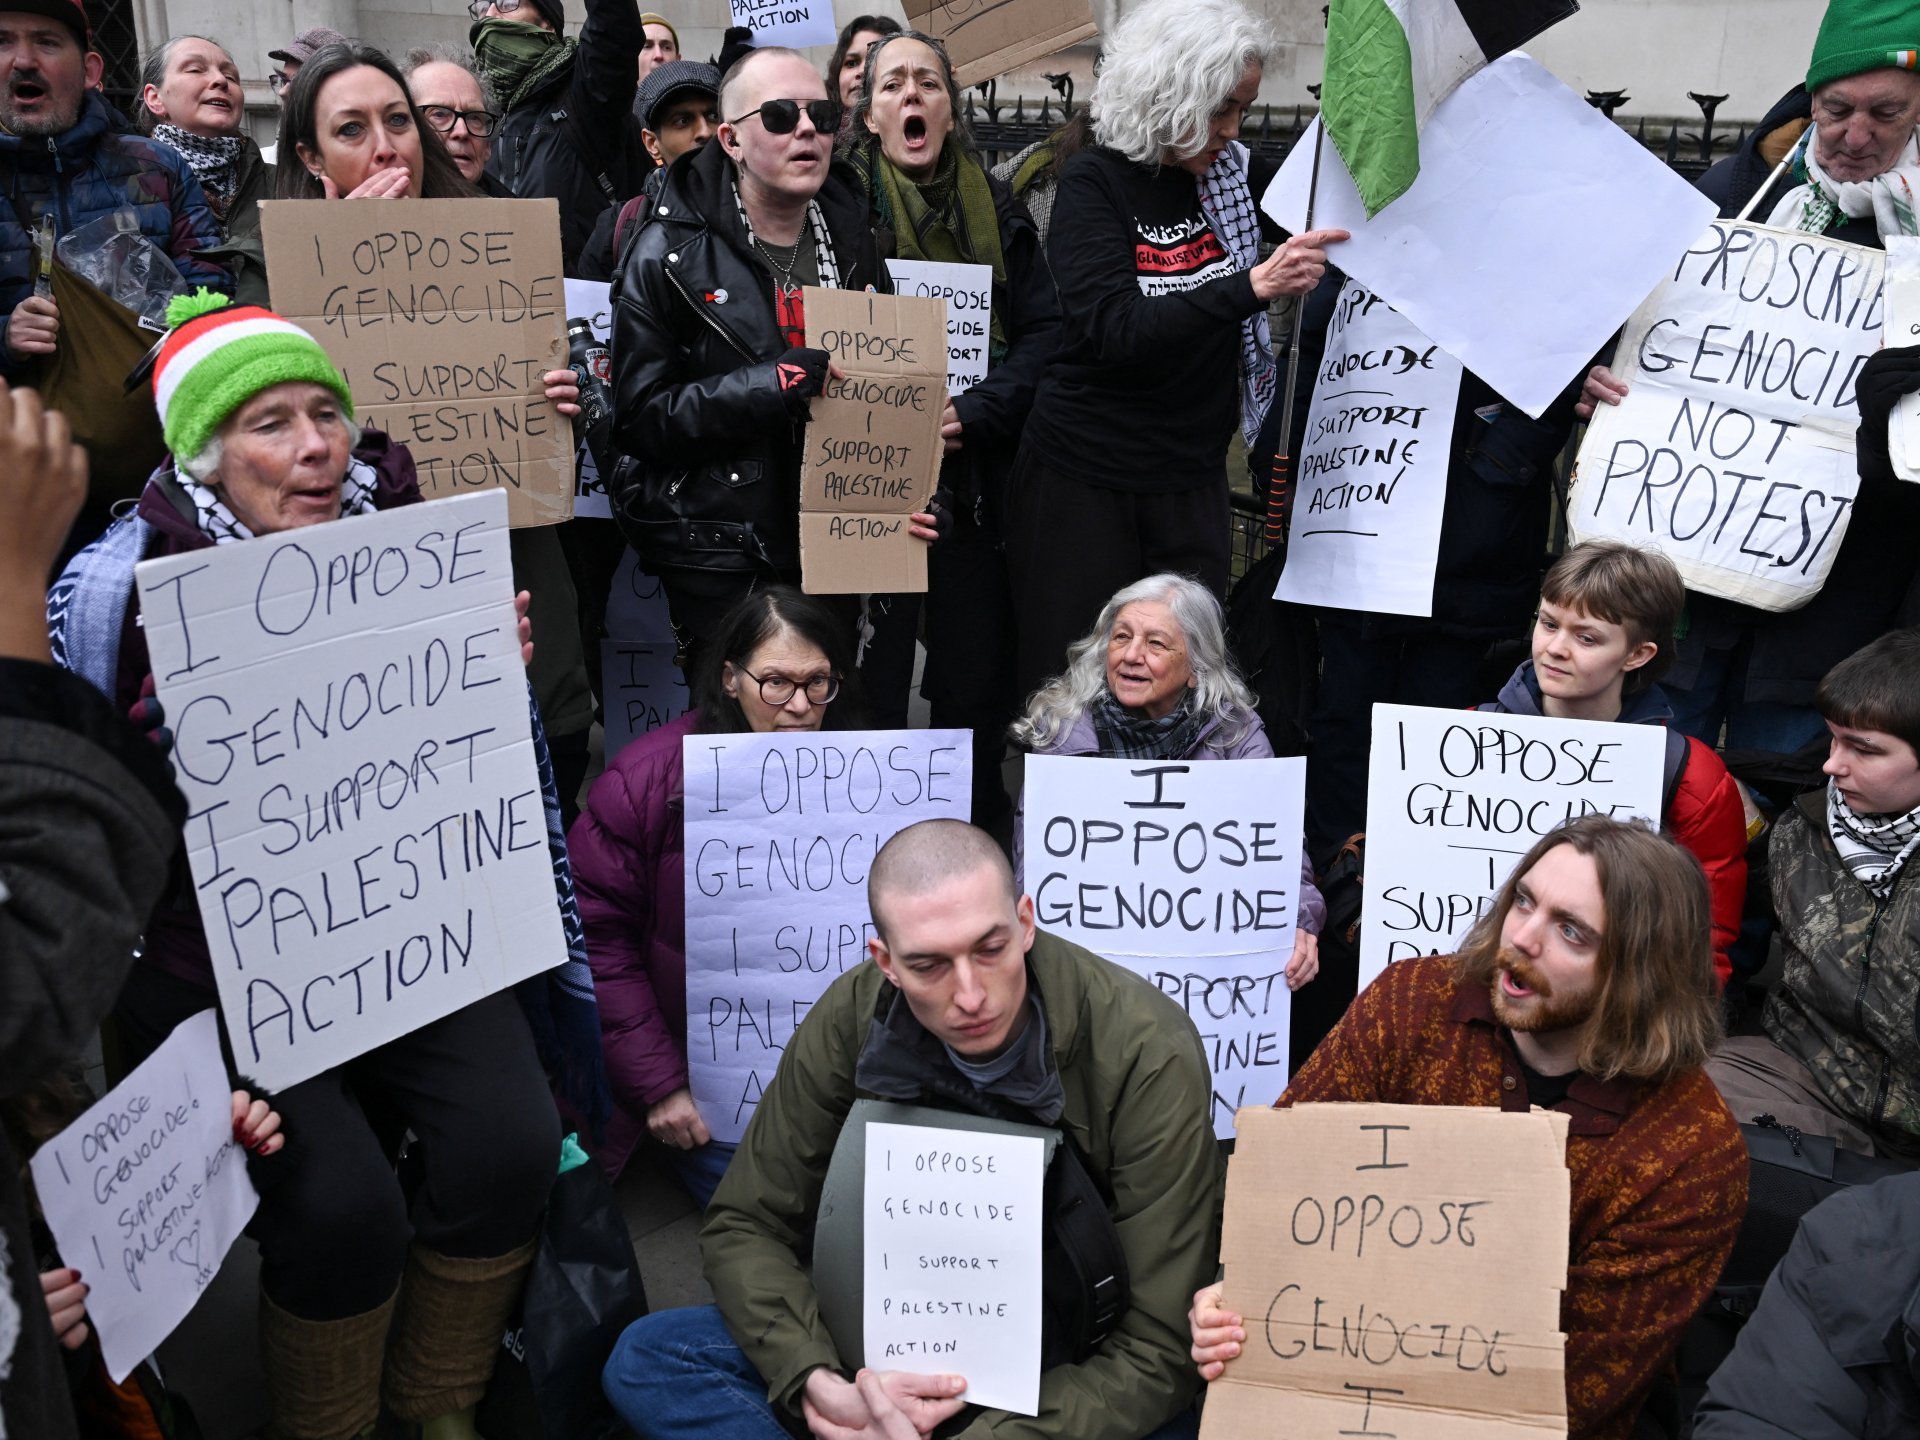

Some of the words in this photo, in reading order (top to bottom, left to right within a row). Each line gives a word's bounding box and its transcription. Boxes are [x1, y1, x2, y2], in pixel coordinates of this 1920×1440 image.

[747, 7, 810, 30] ACTION
[314, 234, 325, 278] I
[352, 230, 514, 275] OPPOSE
[1673, 223, 1885, 332] PROSCRI
[322, 275, 557, 339] GENOCIDE
[868, 297, 874, 325] I
[916, 282, 990, 310] OPPOSE
[1338, 288, 1399, 334] OPP
[820, 330, 919, 364] OPPOSE
[946, 320, 985, 337] CIDE
[372, 353, 538, 401] SUPPORT
[1319, 344, 1439, 386] GENOCIDE
[1637, 318, 1871, 409] GENOCID
[826, 377, 927, 412] GENOCIDE
[364, 400, 549, 444] LESTINE
[866, 410, 873, 434] I
[1312, 405, 1430, 446] SUPPORT
[1667, 396, 1802, 465] NOT
[415, 438, 523, 491] TION
[816, 437, 912, 473] SUPPORT
[1302, 437, 1420, 482] PALESTINE
[824, 471, 914, 502] PALESTINE
[1308, 464, 1407, 515] ACTION
[1593, 438, 1853, 576] PROTEST
[829, 516, 904, 541] ACTION
[145, 564, 222, 682] I
[254, 520, 488, 636] OPPOSE
[172, 628, 502, 786] GENOCIDE
[1397, 720, 1407, 772] I
[1439, 723, 1623, 787] OPPOSE
[708, 746, 728, 814] I
[759, 745, 958, 815] OPPOSE
[1123, 764, 1191, 810] I
[188, 799, 237, 892] I
[257, 726, 498, 857] SUPPORT
[1406, 781, 1636, 837] GENOCI
[695, 830, 900, 898] GENOC
[1043, 815, 1284, 875] OPPOSE
[220, 789, 543, 972] PALESTINE
[1488, 856, 1496, 892] I
[1035, 871, 1289, 935] GENOCIDE
[1381, 885, 1497, 936] SUPP
[732, 926, 740, 978] I
[774, 922, 876, 974] SUPP
[246, 907, 474, 1064] ACTION
[1147, 970, 1285, 1020] PPORT
[55, 1151, 71, 1185] I
[81, 1095, 151, 1164] OPPOSE
[887, 1149, 892, 1172] I
[915, 1151, 998, 1174] OPPOSE
[1355, 1123, 1411, 1171] I
[91, 1234, 106, 1271] I
[118, 1162, 182, 1241] SUPPORT
[884, 1196, 1015, 1222] GENOCIDE
[1291, 1193, 1495, 1259] OPPOSE
[883, 1252, 888, 1271] I
[918, 1255, 1000, 1271] SUPPORT
[883, 1298, 1009, 1318] PALESTINE
[1265, 1283, 1513, 1377] GENOCIDE
[885, 1339, 958, 1359] ACTION
[1338, 1381, 1405, 1440] I
